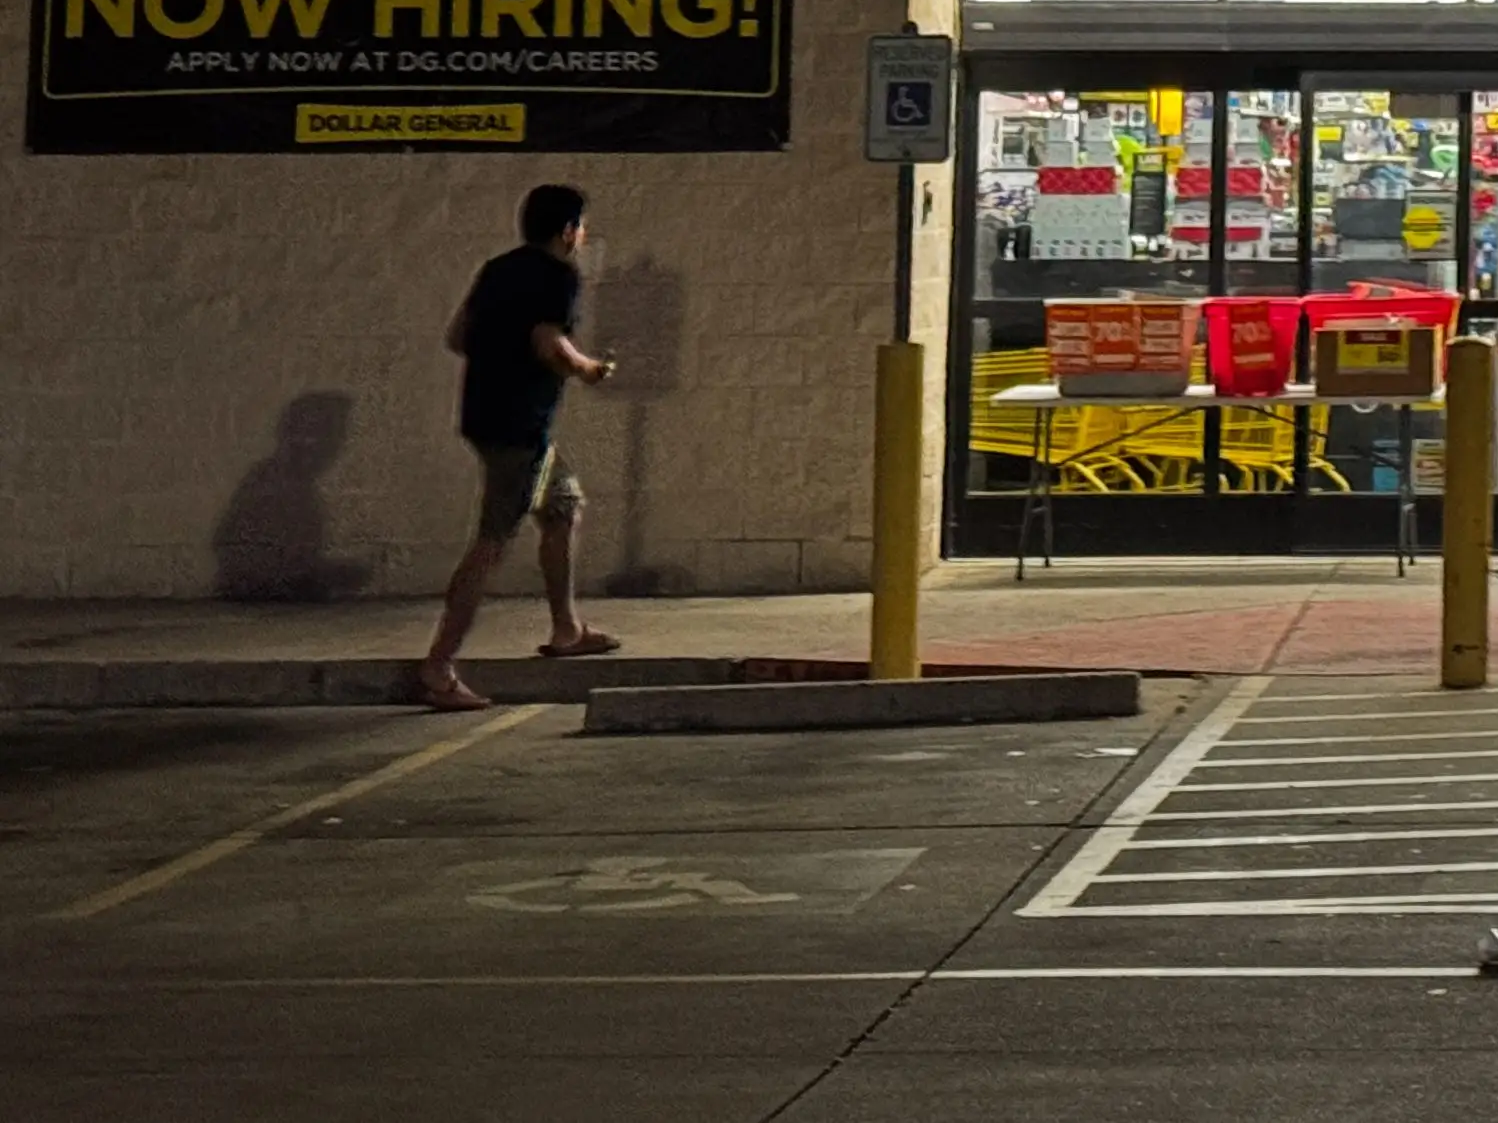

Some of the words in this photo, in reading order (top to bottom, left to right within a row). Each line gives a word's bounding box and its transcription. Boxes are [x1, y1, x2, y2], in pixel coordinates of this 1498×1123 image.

[167, 51, 259, 72] APPLY
[268, 51, 343, 72] NOW
[352, 51, 390, 72] AT
[397, 50, 659, 72] DG.COM/CAREERS
[308, 114, 404, 133] DOLLAR
[407, 114, 514, 133] GENERAL
